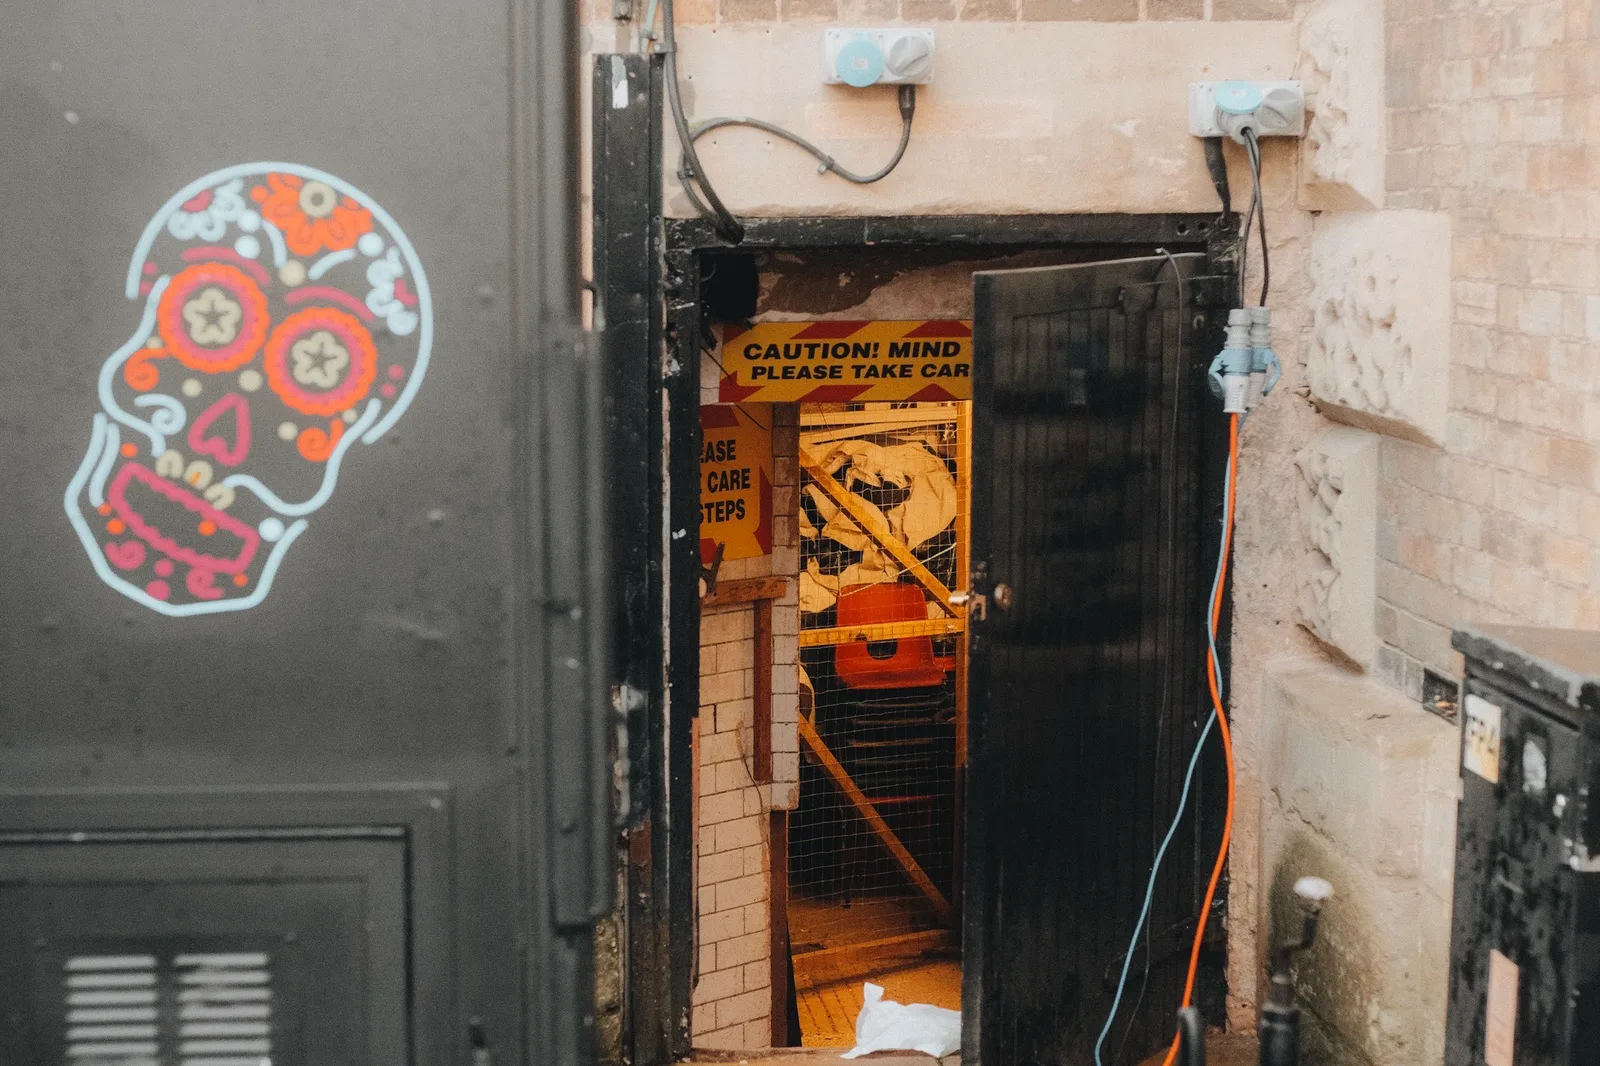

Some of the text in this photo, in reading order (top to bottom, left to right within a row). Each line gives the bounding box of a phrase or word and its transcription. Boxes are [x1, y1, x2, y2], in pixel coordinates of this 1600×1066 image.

[743, 341, 961, 360] CAUTION! MIND
[751, 363, 970, 379] PLEASE TAKE CAR
[707, 468, 750, 493] CARE
